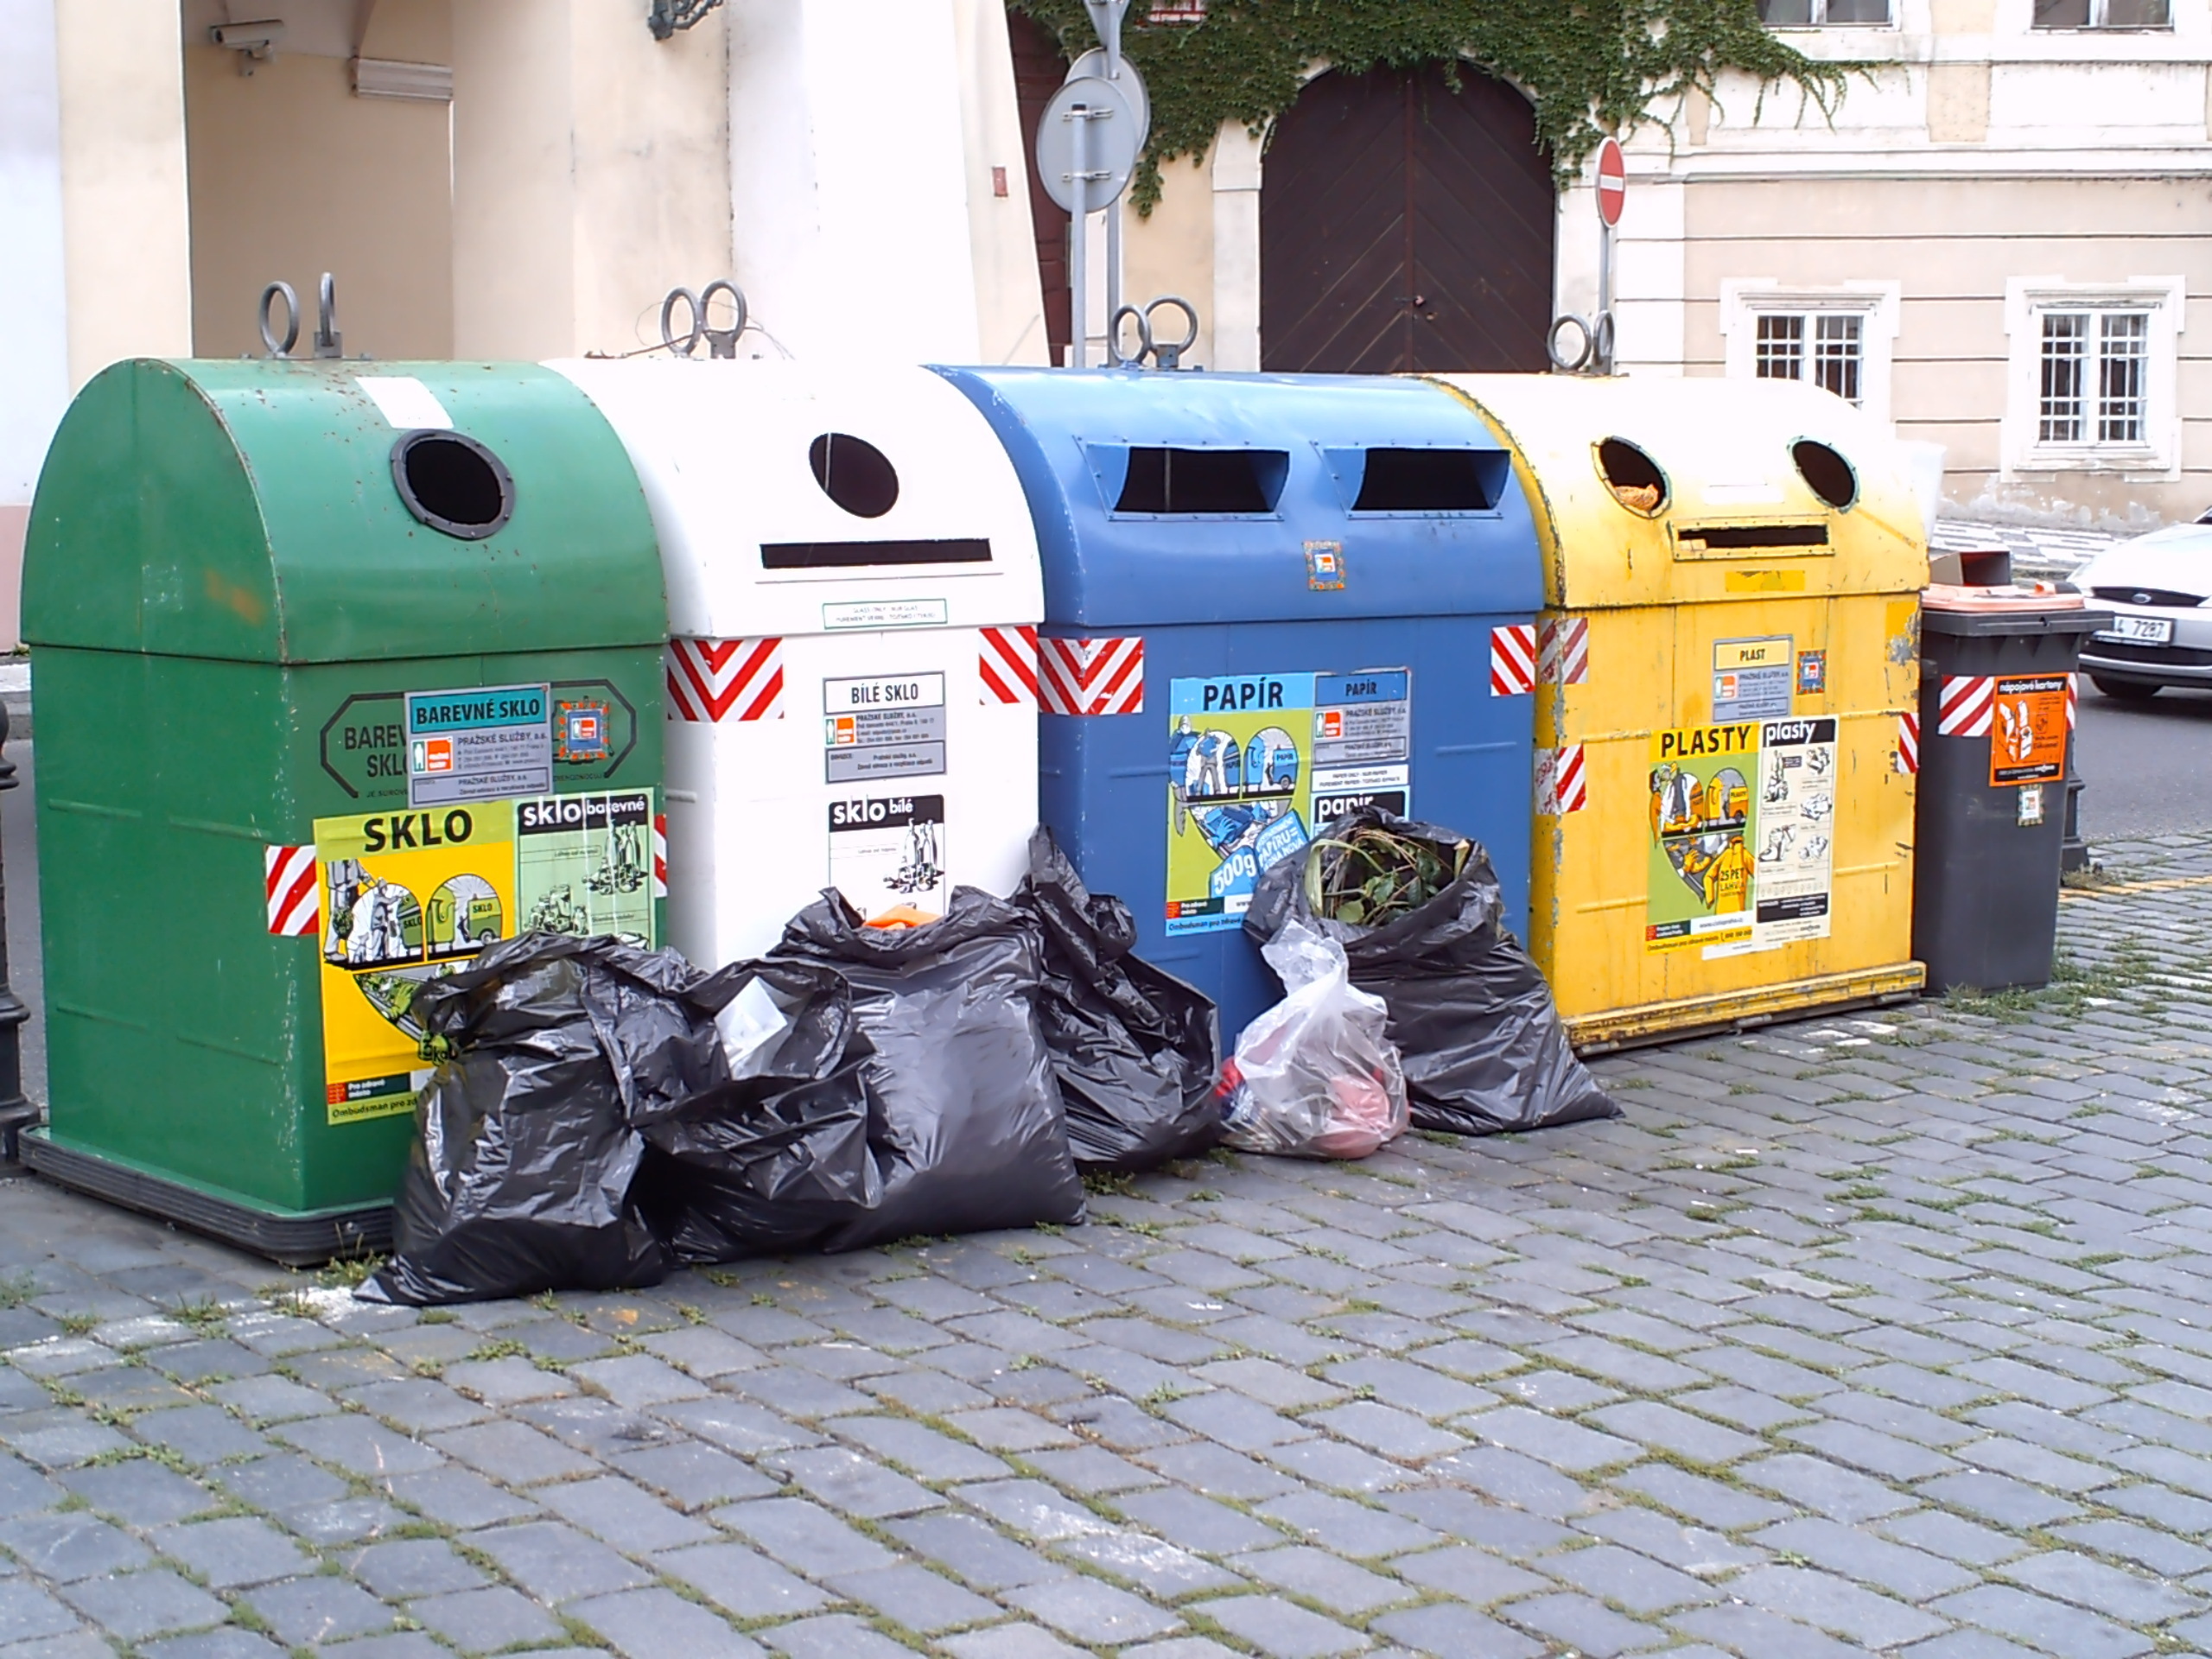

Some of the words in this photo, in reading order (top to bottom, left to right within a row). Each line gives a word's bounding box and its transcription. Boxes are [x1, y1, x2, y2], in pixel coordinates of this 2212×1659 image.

[2133, 620, 2164, 638] 7287
[1739, 648, 1765, 662] PLAST
[851, 683, 880, 704] BÍLÉ
[885, 683, 918, 702] SKLO
[1203, 677, 1283, 712] PAPÍR
[1345, 678, 1376, 696] PAPÍR
[416, 698, 494, 725] BAREVNÉ
[499, 698, 540, 718] SKLO
[458, 733, 497, 746] PRAŽSKÉ
[1661, 724, 1751, 758] PLASTY
[1766, 722, 1815, 747] plasty
[524, 796, 582, 826] sklo
[586, 796, 645, 816] barevné
[833, 796, 887, 824] sklo
[889, 798, 913, 815] bílé
[1319, 792, 1374, 823] papír
[365, 808, 472, 853] SKLO
[1213, 854, 1257, 894] 500g
[1730, 868, 1745, 880] PET
[473, 903, 493, 913] SKLO
[333, 1103, 388, 1118] Ombudsman
[390, 1101, 405, 1111] pro
